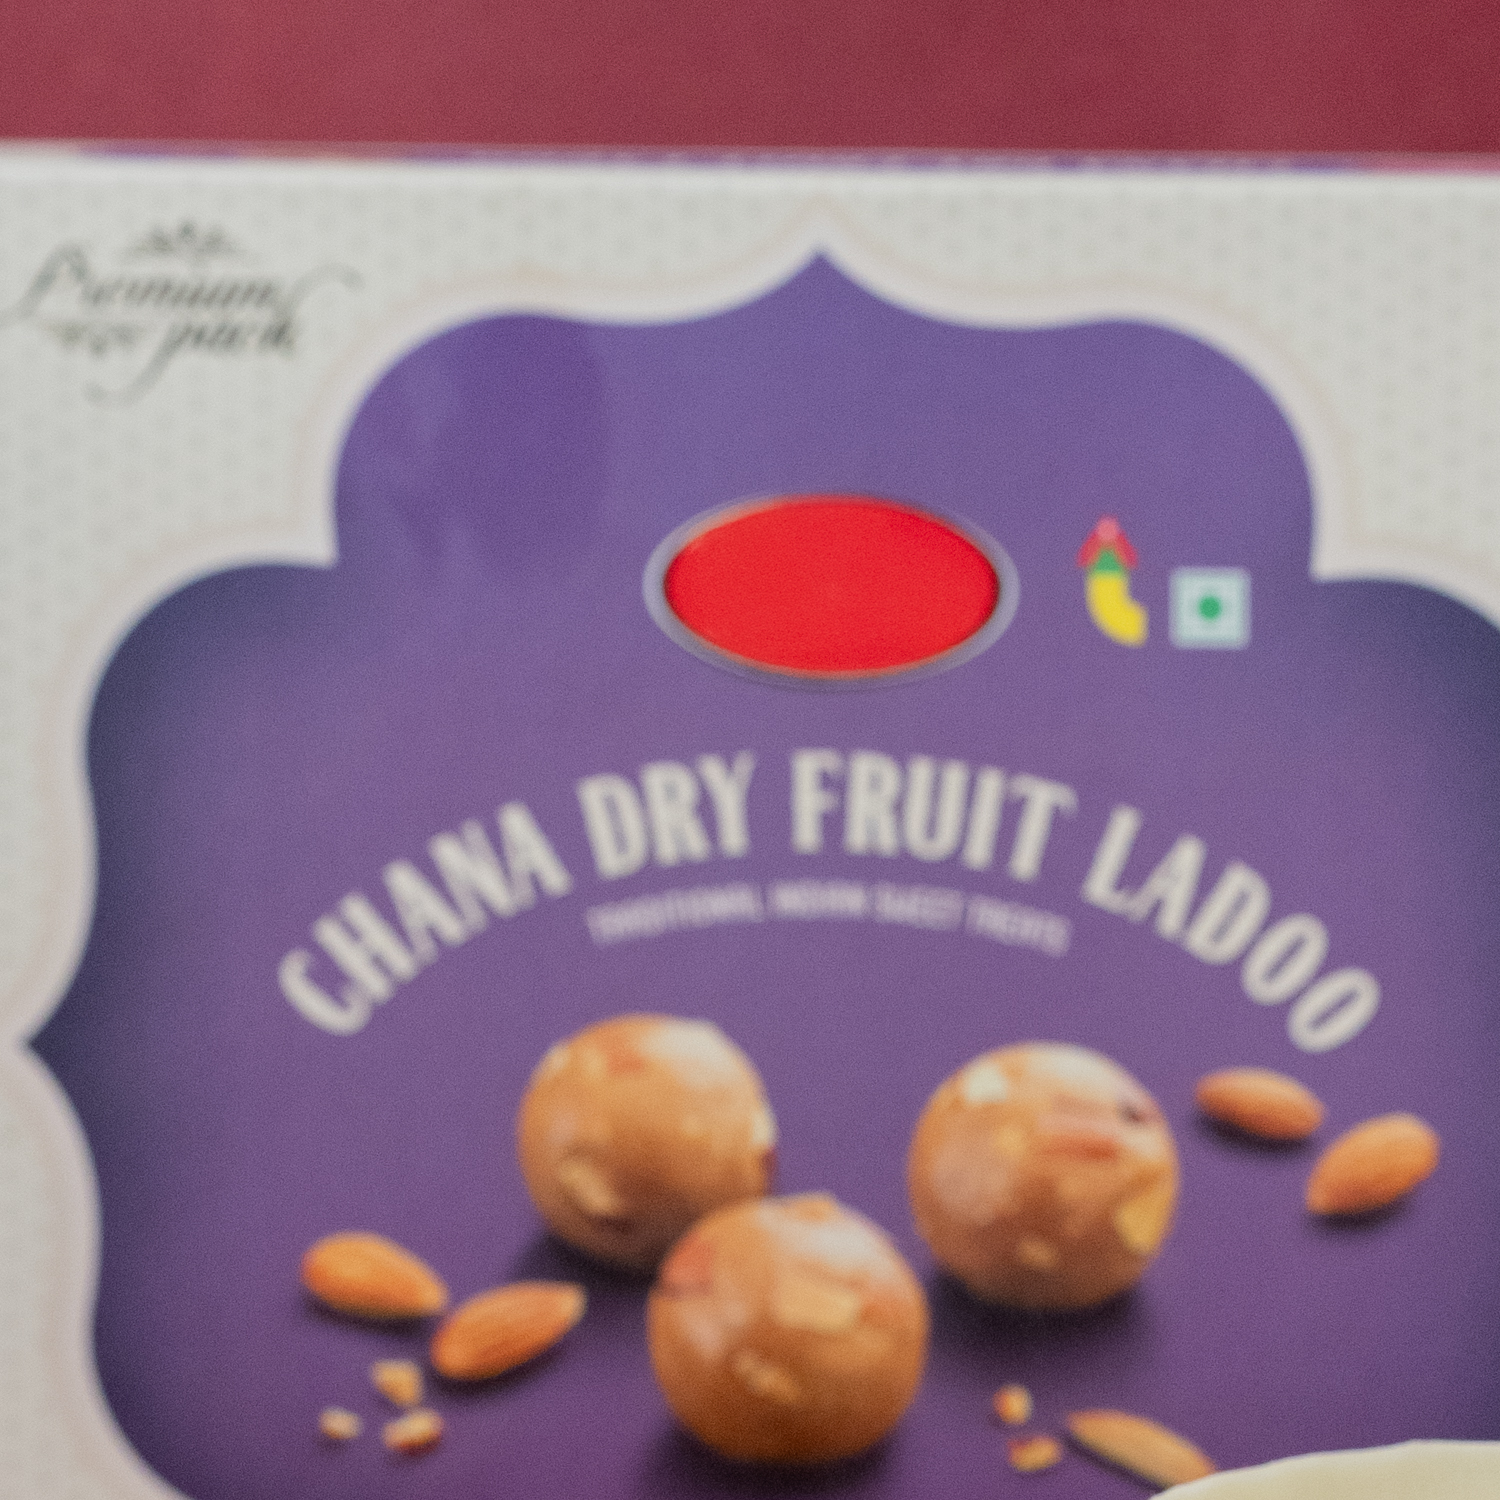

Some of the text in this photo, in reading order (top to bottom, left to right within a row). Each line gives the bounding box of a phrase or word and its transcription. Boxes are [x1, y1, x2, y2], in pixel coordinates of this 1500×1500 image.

[277, 747, 1383, 1055] CHANA DRY FRUIT LADOO
